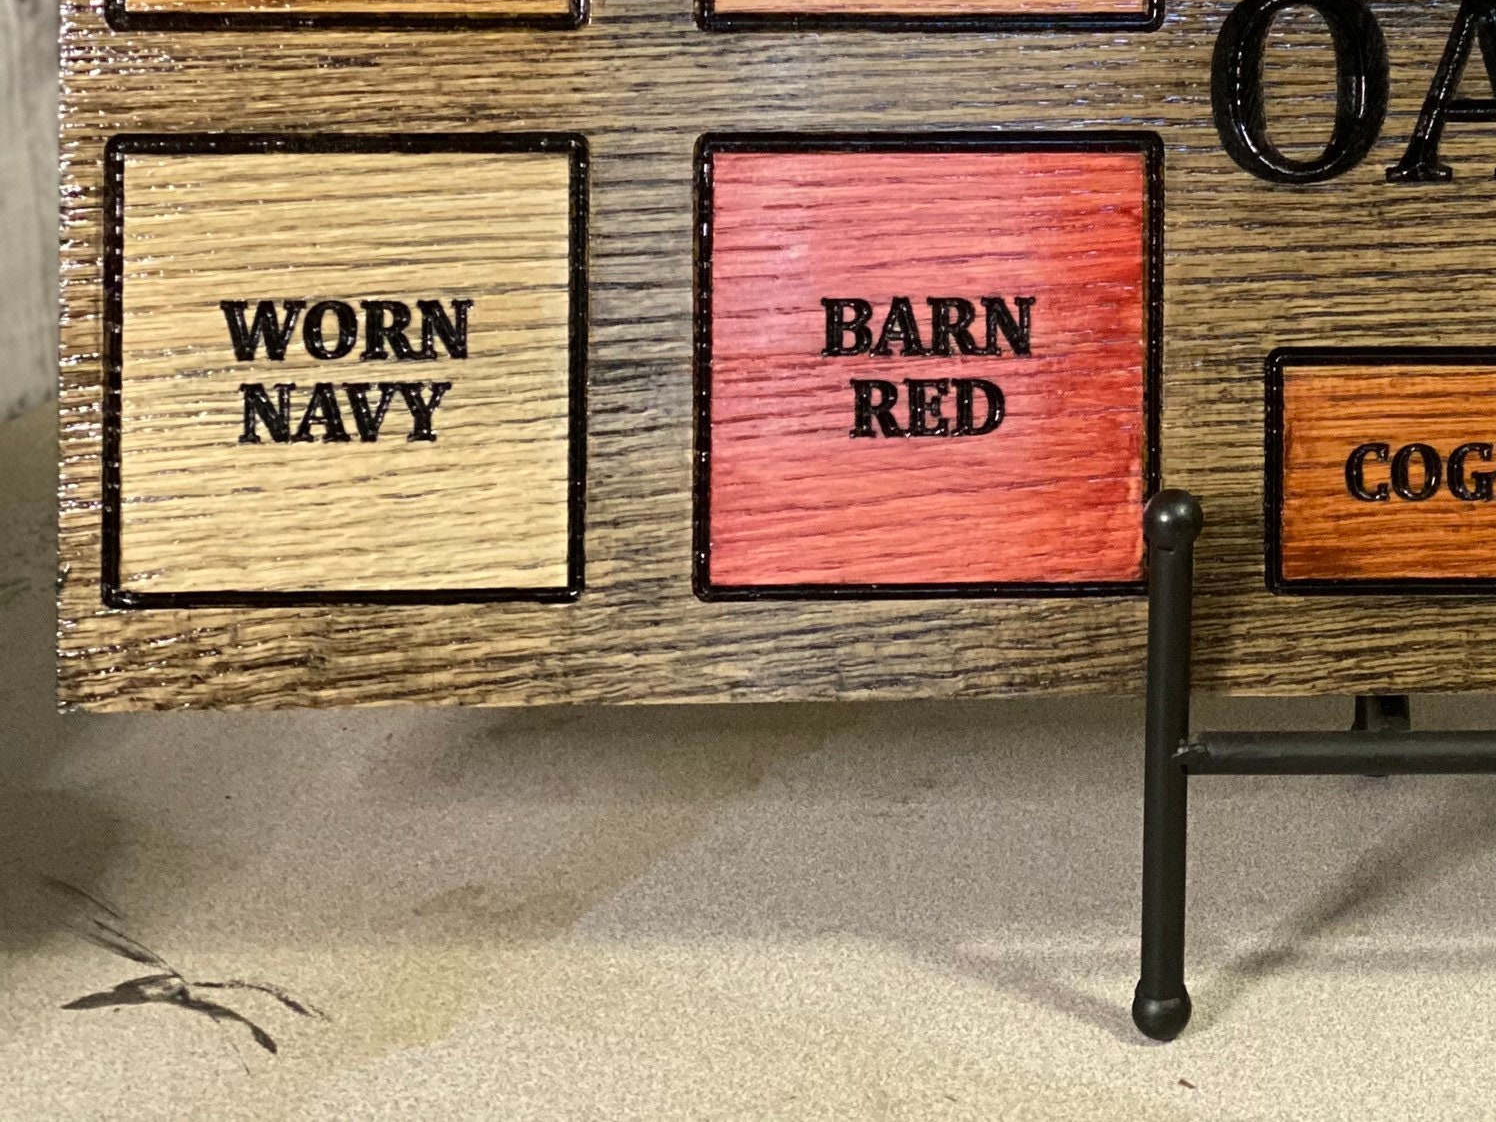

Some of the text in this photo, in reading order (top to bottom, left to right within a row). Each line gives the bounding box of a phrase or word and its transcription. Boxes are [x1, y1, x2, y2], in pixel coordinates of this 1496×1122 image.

[219, 298, 473, 362] WORN
[820, 295, 1035, 358] BARN
[239, 381, 451, 444] NAVY
[849, 377, 1005, 439] RED
